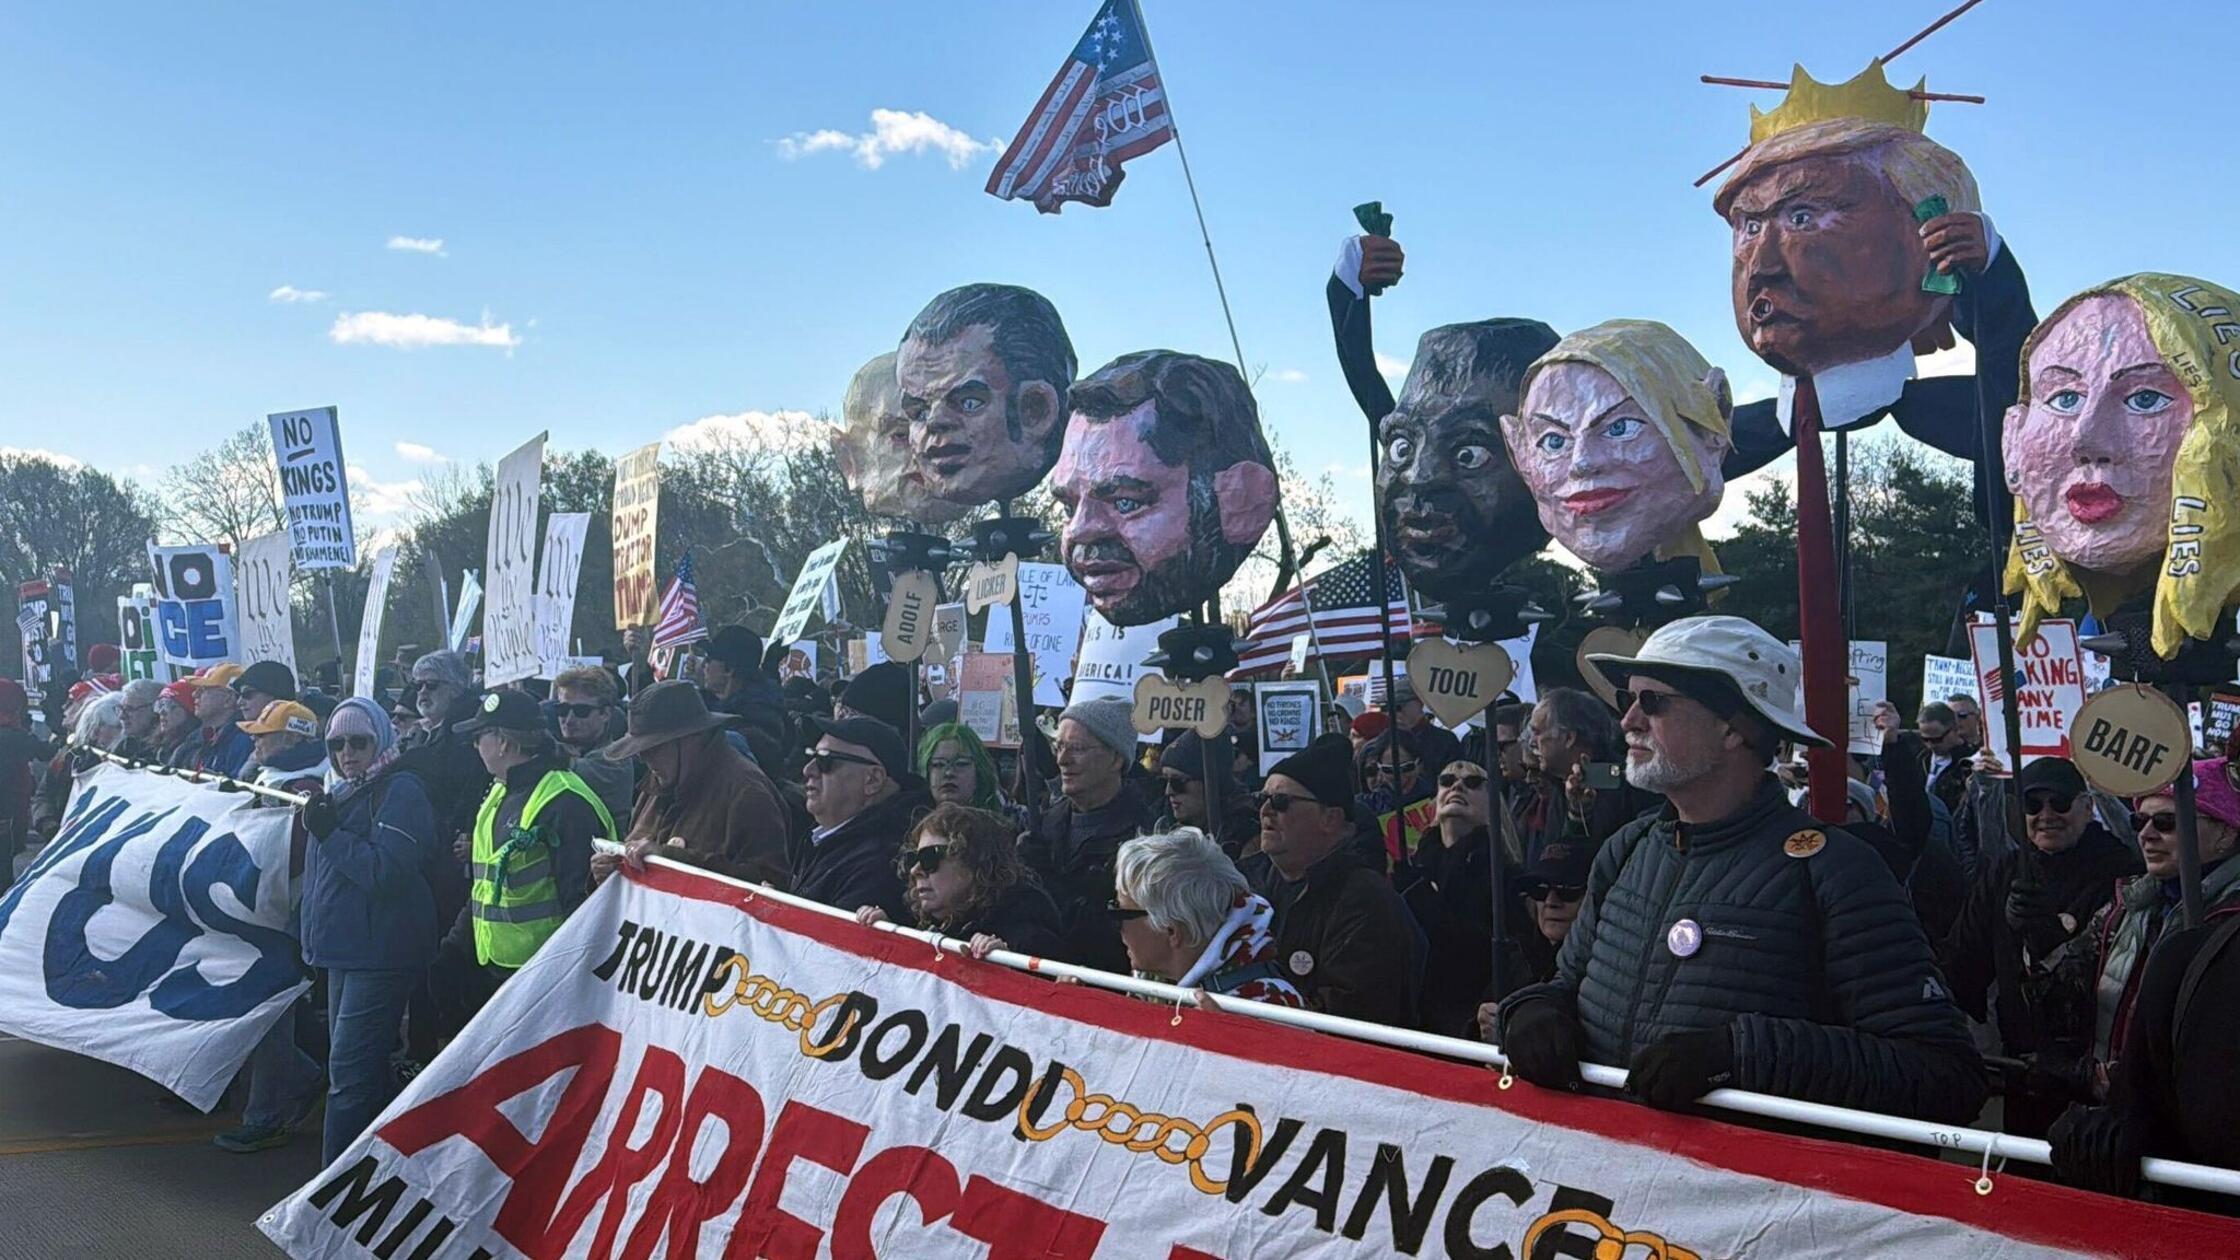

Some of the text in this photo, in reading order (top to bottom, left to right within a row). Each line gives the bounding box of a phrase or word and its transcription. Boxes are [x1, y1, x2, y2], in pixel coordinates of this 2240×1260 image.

[2172, 352, 2201, 388] LIES
[282, 417, 313, 449] NO
[281, 461, 337, 497] KINGS
[289, 502, 342, 523] NO TRUMP
[614, 507, 648, 543] DUMP
[294, 526, 343, 544] NO PUTIN
[2015, 522, 2053, 577] LIES
[2168, 496, 2206, 577] LIES
[614, 533, 653, 577] TRAITOR
[976, 573, 1006, 600] LICKER
[1040, 571, 1053, 583] OF
[159, 600, 228, 660] CE
[897, 591, 921, 645] ADOLF
[1111, 625, 1125, 640] IS
[1042, 635, 1063, 652] ONE
[1428, 666, 1479, 699] TOOL
[2024, 657, 2078, 686] KING
[1150, 697, 1205, 722] POSER
[2017, 689, 2054, 708] ANY
[2214, 720, 2231, 729] GO
[2084, 718, 2169, 776] BARF
[592, 919, 736, 1015] TRUMP
[816, 990, 1066, 1143] BONDI
[1929, 1131, 1962, 1147] TOP
[1224, 1102, 1615, 1260] VANCE
